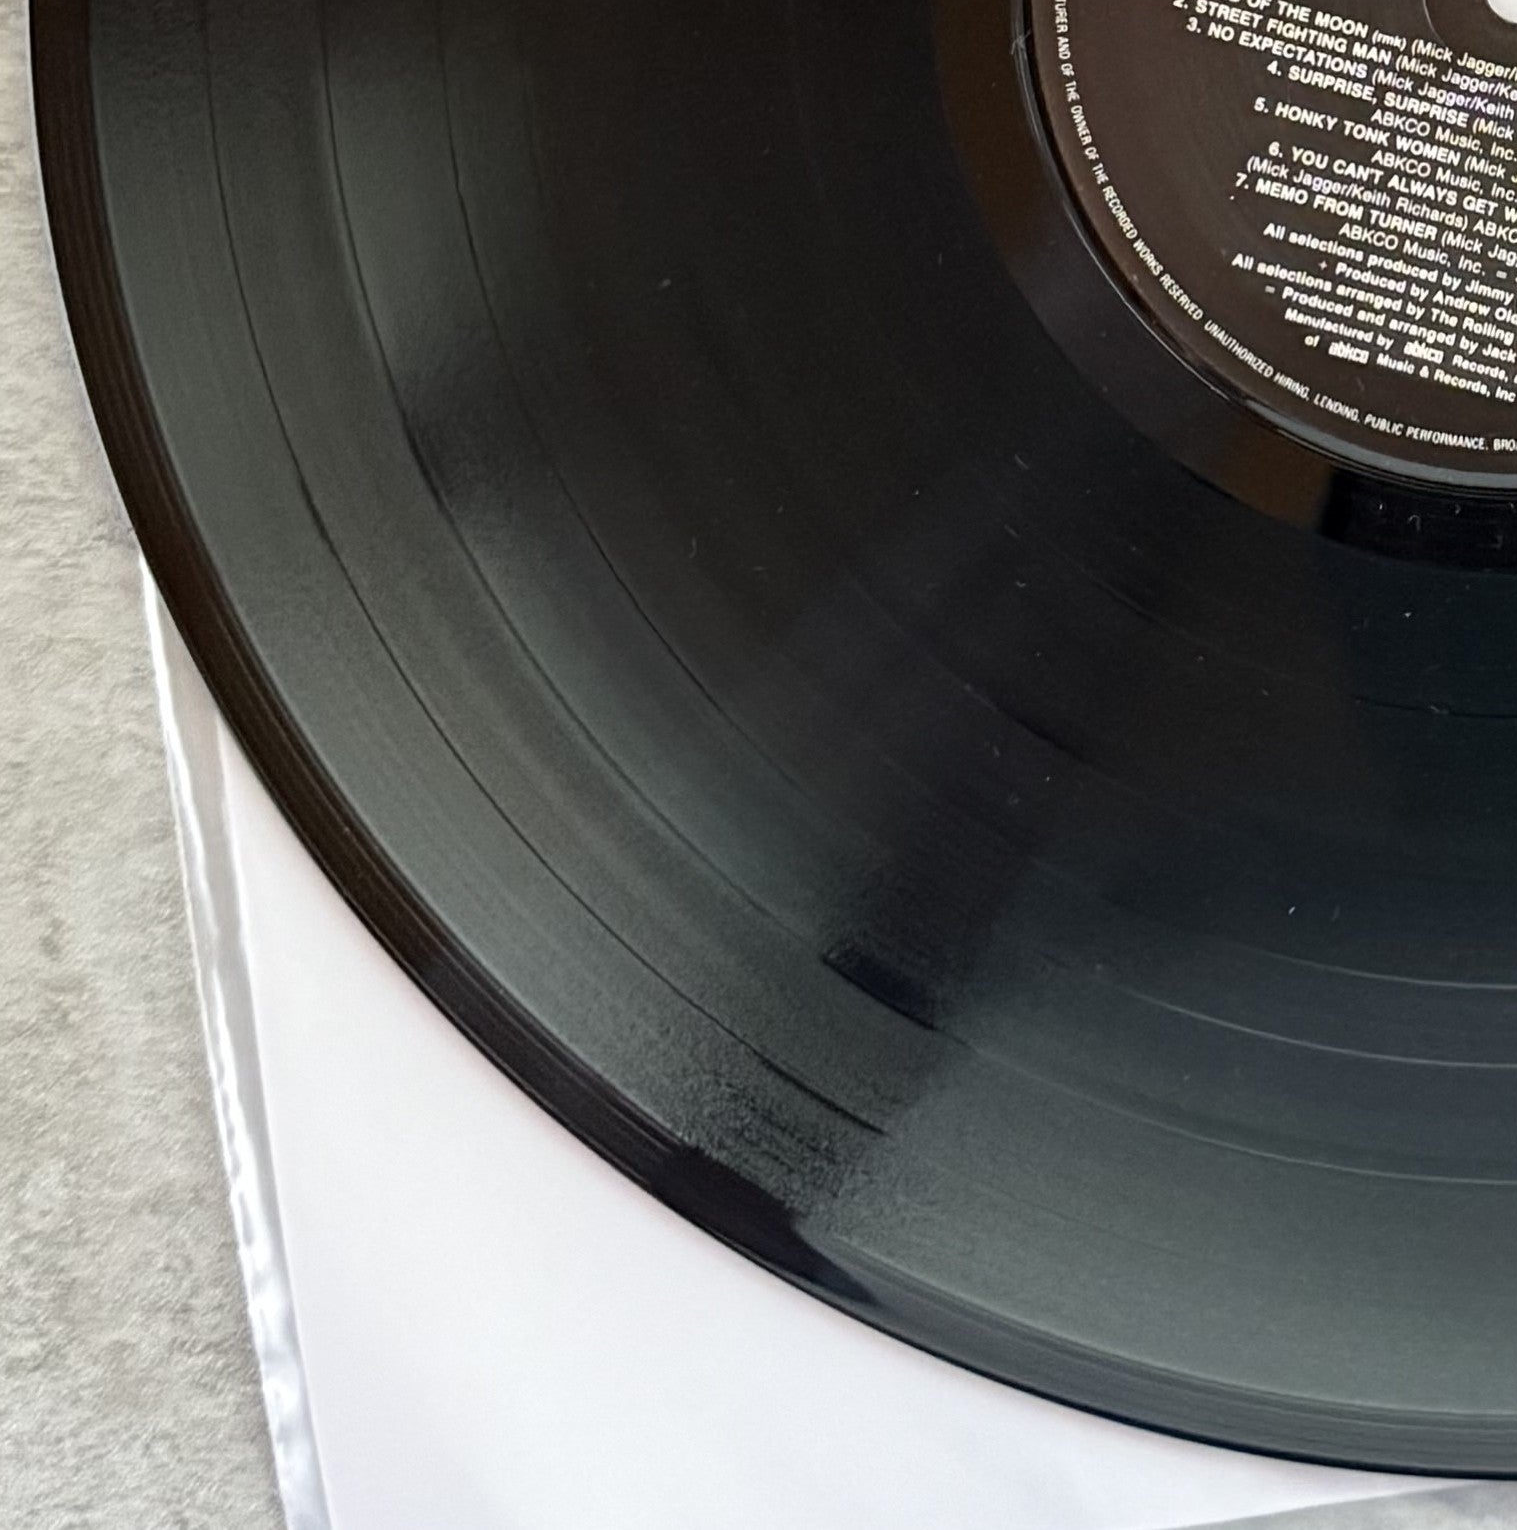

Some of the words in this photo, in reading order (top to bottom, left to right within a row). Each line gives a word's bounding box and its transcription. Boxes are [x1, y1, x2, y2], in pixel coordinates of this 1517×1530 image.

[1185, 16, 1201, 33] 3.
[1207, 21, 1235, 41] NO
[1238, 30, 1368, 78] EXPECTATIONS
[1371, 68, 1414, 92] (Mick
[1417, 81, 1514, 120] Jagger/Keith
[1265, 17, 1347, 53] FIGHTING
[1351, 41, 1392, 65] MAN
[1394, 54, 1437, 78] (Mick
[1277, 0, 1311, 23] THE
[1314, 10, 1369, 38] MOON
[1410, 38, 1453, 62] (Mick
[1253, 96, 1269, 113] 5.
[1274, 101, 1338, 131] HONKY
[1343, 119, 1390, 147] TONK
[1395, 134, 1461, 166] WOMEN
[1463, 154, 1506, 179] (Mick
[1266, 59, 1281, 76] 4.
[1383, 91, 1469, 128] SURPRISE
[1471, 116, 1514, 141] (Mick
[1370, 108, 1430, 137] ABKCO
[1489, 141, 1517, 162] Inc.
[1235, 171, 1249, 189] 7.
[1254, 177, 1308, 204] MEMO
[1312, 193, 1364, 221] FROM
[1369, 208, 1438, 241] TURNER
[1440, 229, 1483, 254] (Mick
[1246, 155, 1289, 179] (Mick
[1292, 168, 1391, 208] Jagger/Keith
[1394, 196, 1468, 231] Richards)
[1268, 140, 1283, 158] 6.
[1291, 145, 1329, 169] YOU
[1386, 174, 1458, 206] ALWAYS
[1462, 194, 1499, 216] GET
[1370, 149, 1431, 177] ABKCO
[1490, 182, 1517, 203] Inc.
[1338, 222, 1399, 250] ABKCO
[1457, 254, 1485, 276] Inc.
